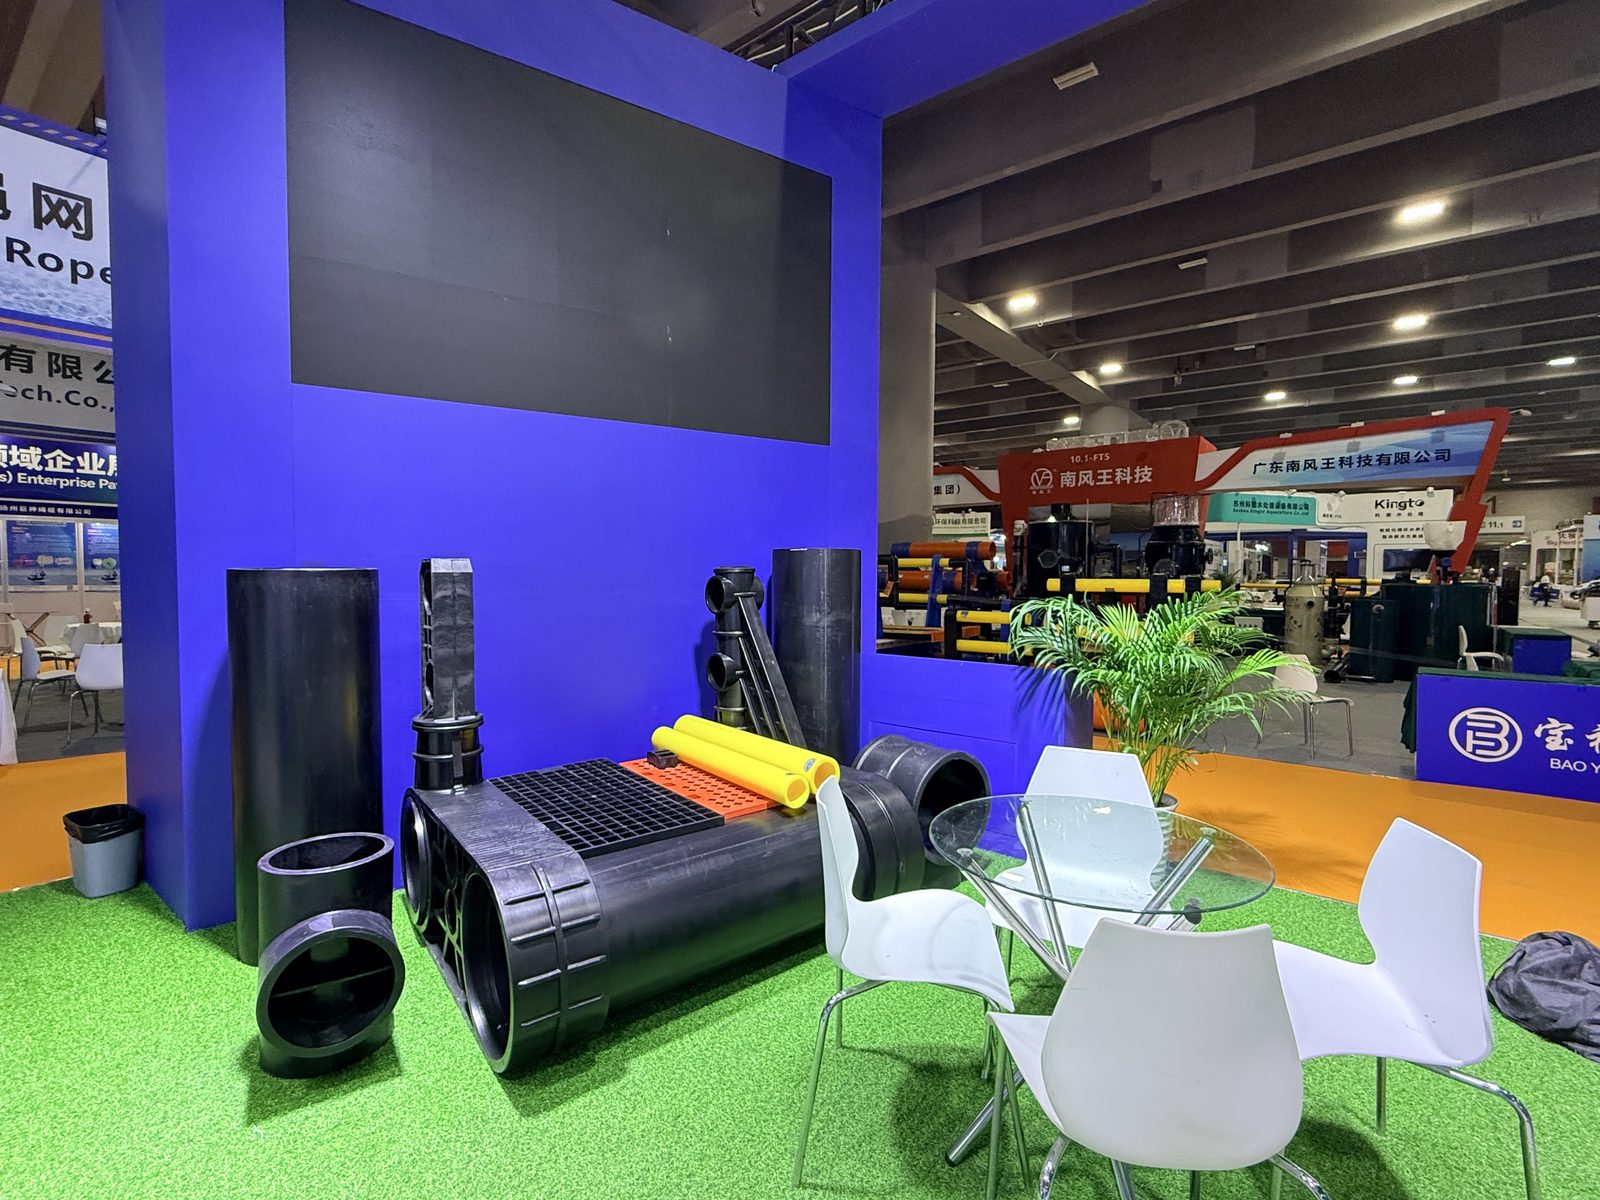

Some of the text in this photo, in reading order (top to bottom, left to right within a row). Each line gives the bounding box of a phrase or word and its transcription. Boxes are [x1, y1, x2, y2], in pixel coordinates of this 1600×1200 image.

[0, 172, 93, 241] 网
[1071, 453, 1110, 463] 10.1-FT5
[1253, 449, 1451, 475] 广东南风王科技有限公司
[17, 472, 96, 489] Enterprise
[99, 479, 117, 490] Pa
[1060, 465, 1153, 488] 南风王科技
[1550, 758, 1587, 772] BAO
